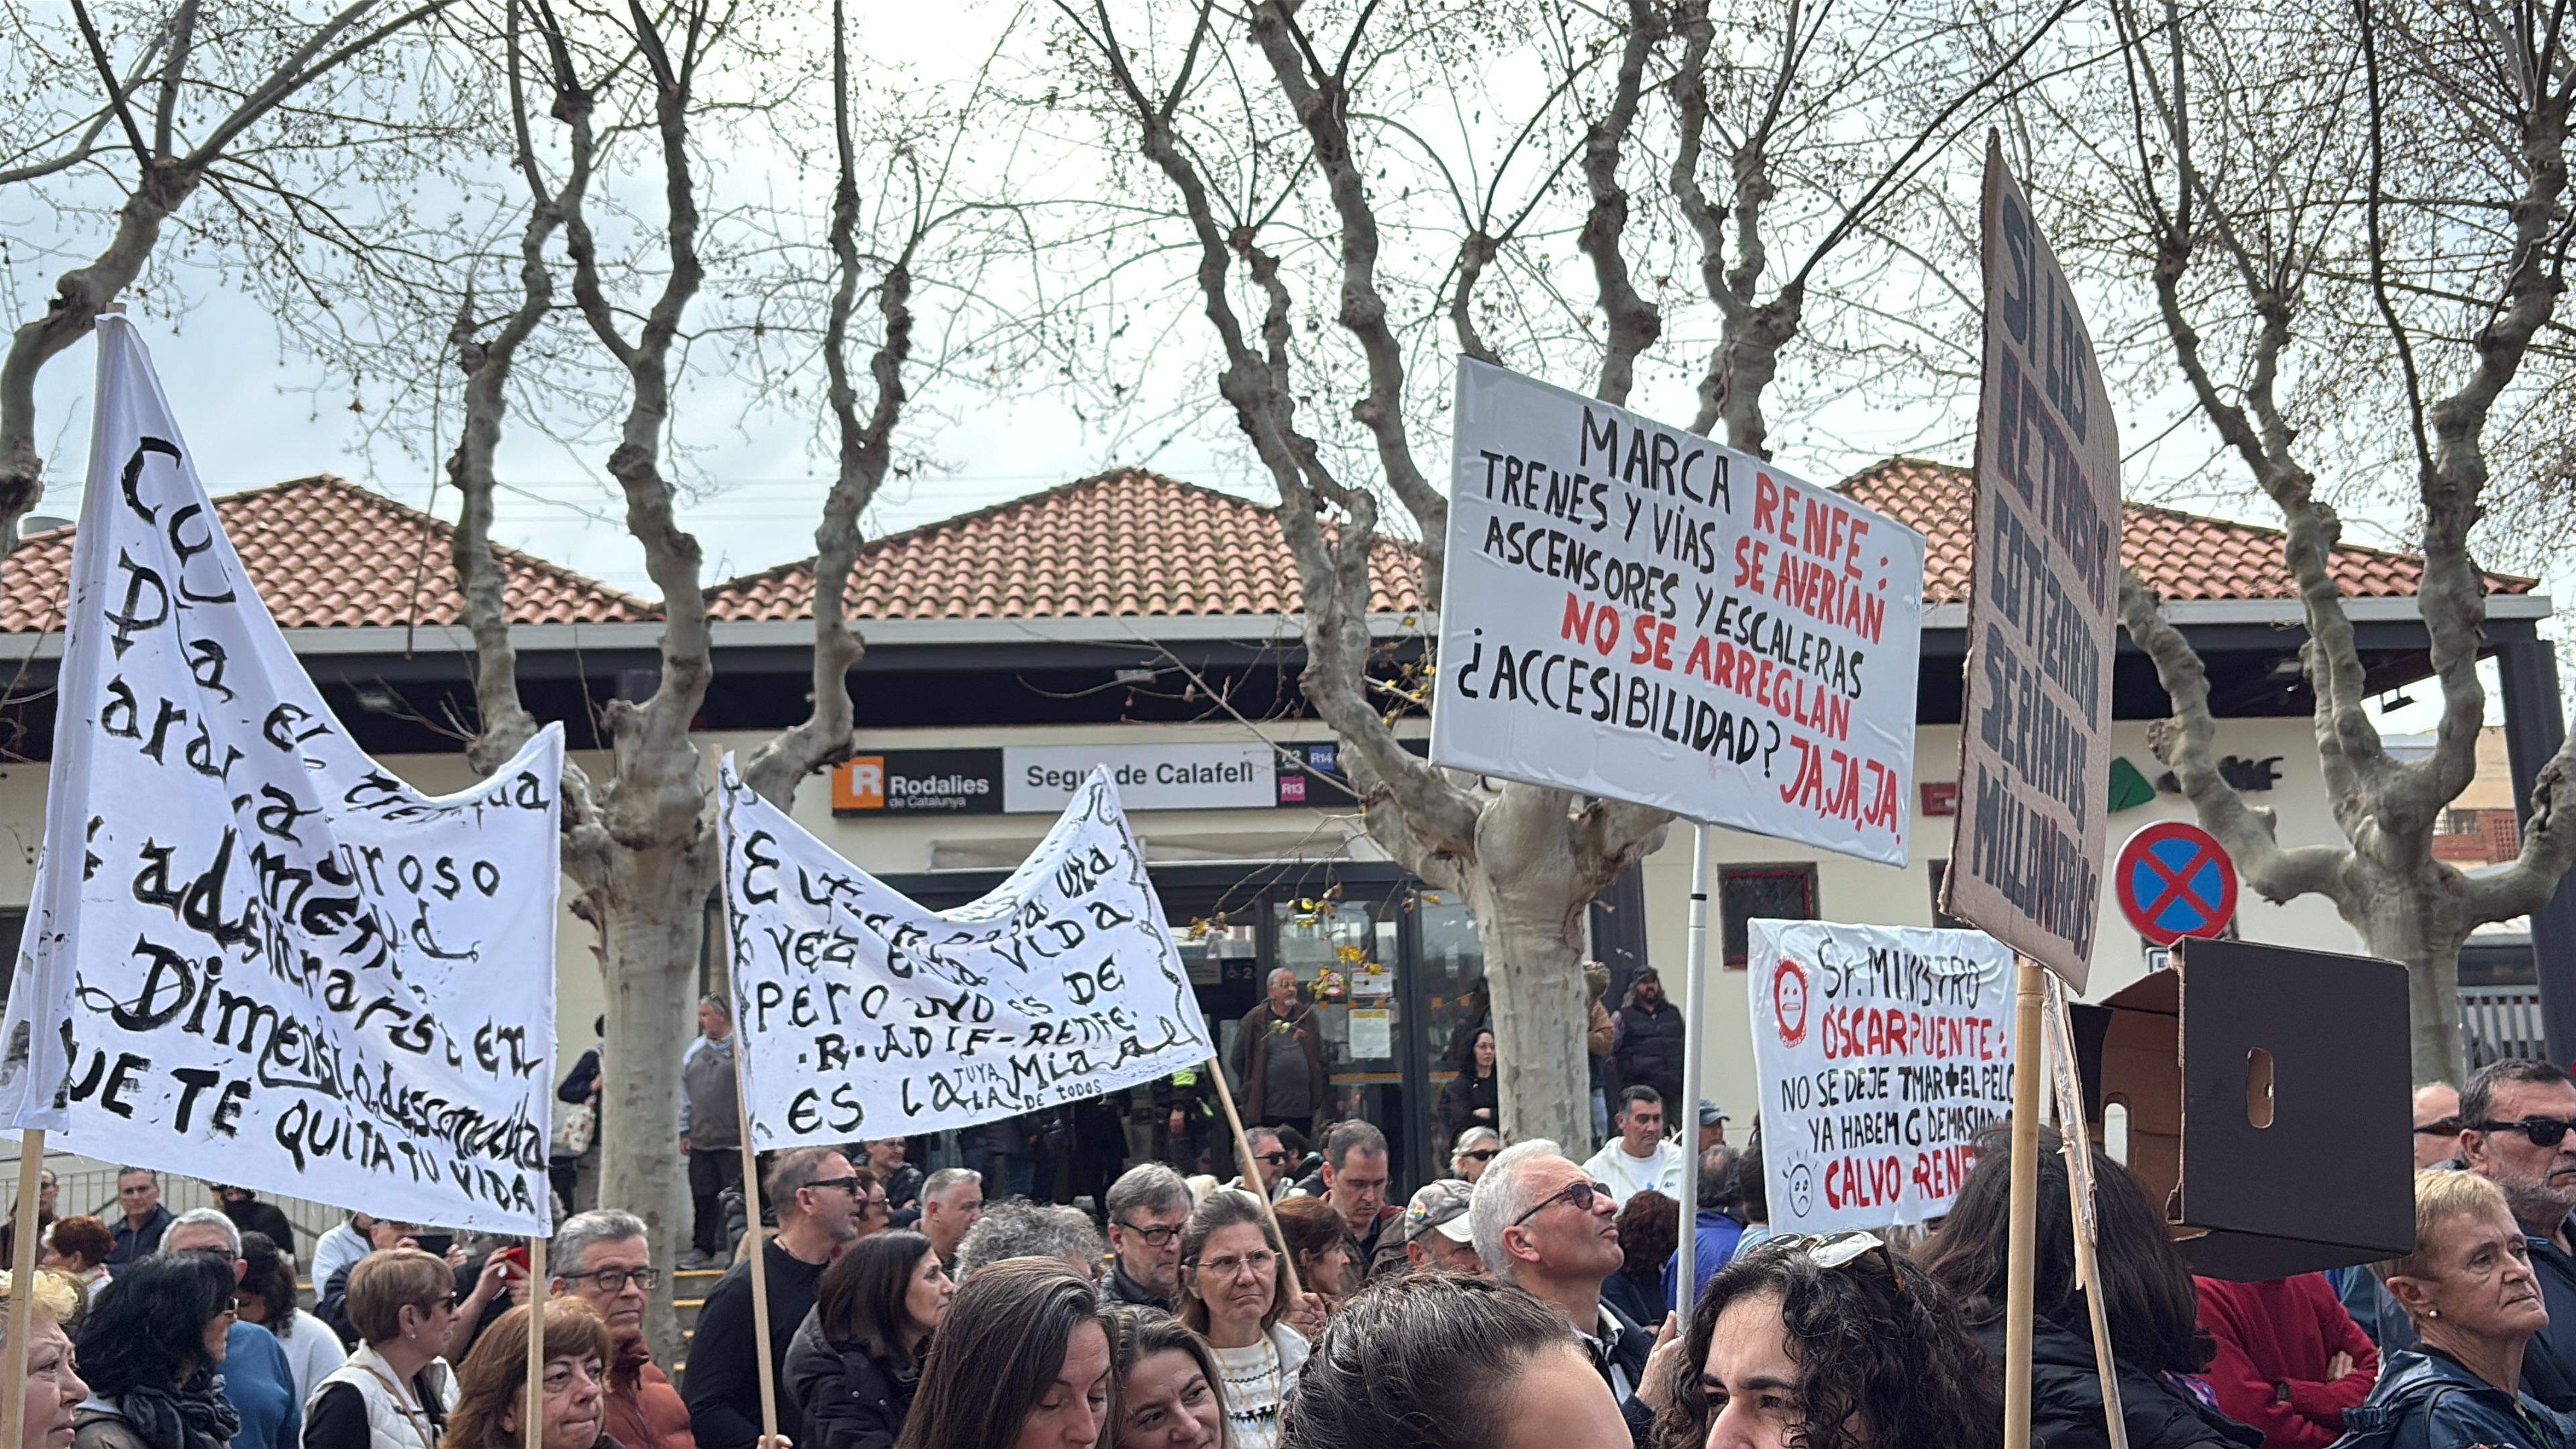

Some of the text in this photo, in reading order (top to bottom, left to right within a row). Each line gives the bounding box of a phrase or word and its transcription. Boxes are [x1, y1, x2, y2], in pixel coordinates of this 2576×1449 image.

[2046, 270, 2086, 446] LOS
[1580, 406, 1731, 515] MARCA
[1997, 341, 2108, 616] RETRASOS
[1480, 450, 1608, 533] TRENES
[1623, 491, 1642, 542] Y
[1734, 535, 1768, 594] SE
[1772, 556, 1886, 645] AVERÍAN
[1484, 517, 1864, 700] ASCENSORES Y ESCALERAS
[1560, 592, 1851, 742] NO SE ARREGLAN
[1458, 628, 1781, 778] ¿ACCESIBILIDAD?
[852, 764, 882, 796] R
[1116, 764, 1146, 785] de
[1156, 762, 1253, 784] Calafell
[1309, 752, 1334, 764] R14
[889, 796, 967, 809] de Catalunya
[890, 775, 989, 795] Rodalies
[1281, 782, 1305, 795] R13
[1063, 954, 1126, 1006] DE
[1868, 946, 1980, 1010] MINISTRO
[1024, 1093, 1044, 1111] DE
[1782, 1076, 1810, 1112] NO
[1817, 1068, 1839, 1108] SE
[1845, 1066, 1890, 1103] DEJE
[170, 1068, 252, 1139] TE
[397, 1140, 441, 1184] TU
[449, 1159, 536, 1214] VIDA
[1808, 1117, 1835, 1153] YA
[1825, 1155, 1901, 1210] CALVO
